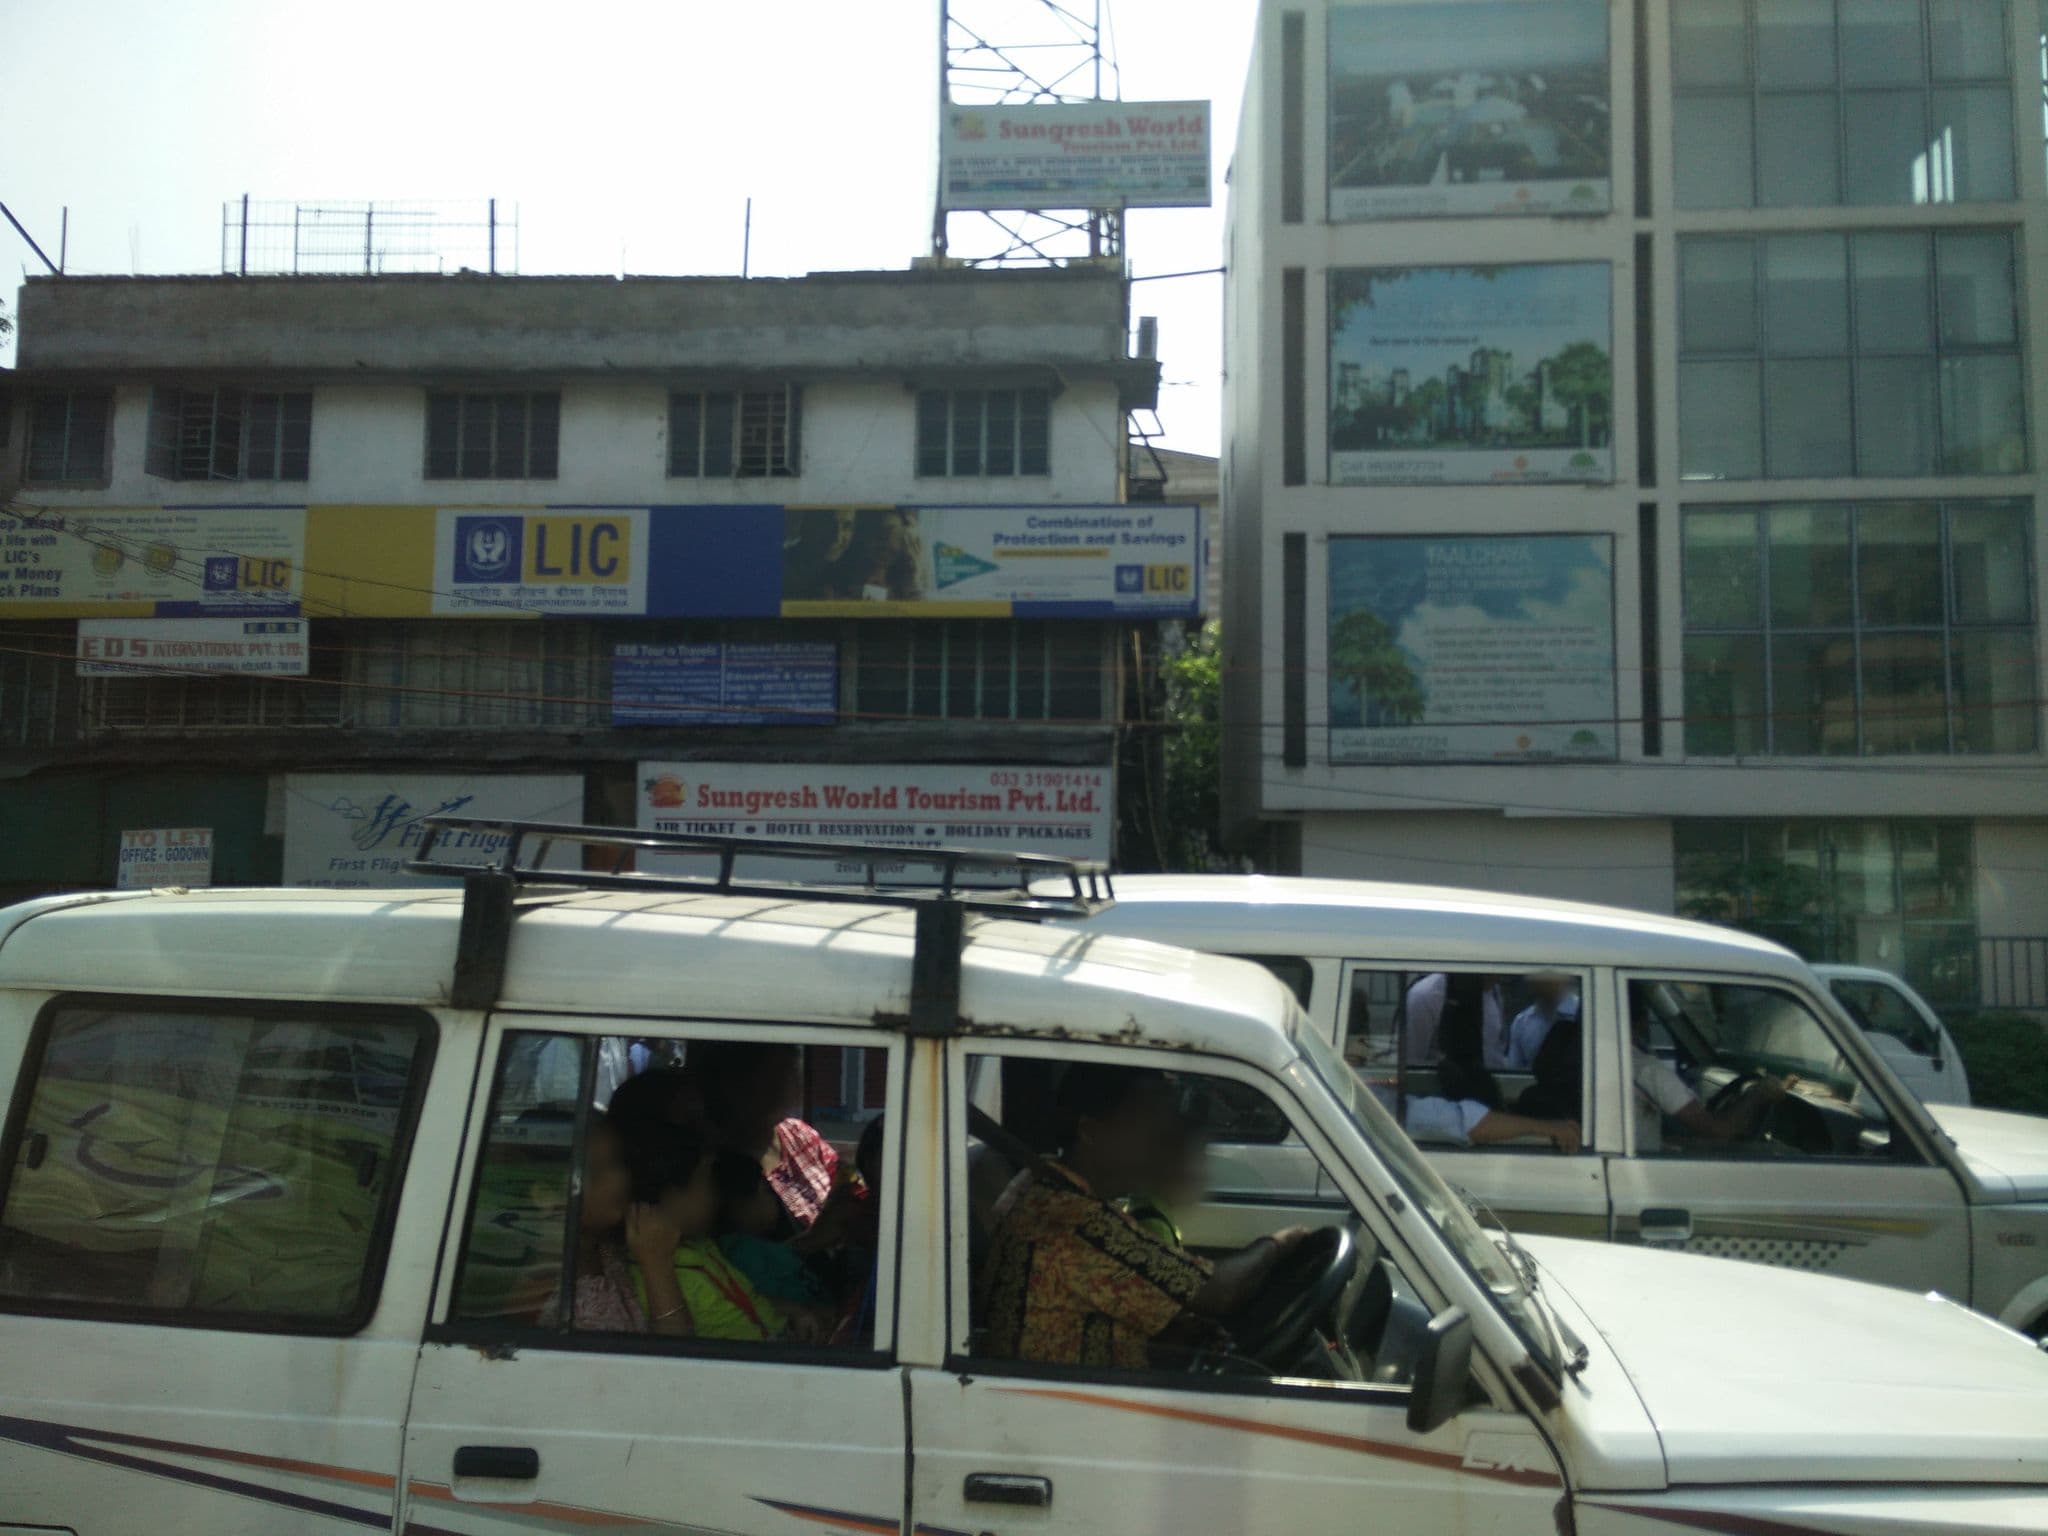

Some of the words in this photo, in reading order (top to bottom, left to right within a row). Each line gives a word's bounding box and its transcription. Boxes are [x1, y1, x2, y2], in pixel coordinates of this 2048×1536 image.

[999, 117, 1121, 145] Sungresh
[1126, 114, 1204, 137] World
[1026, 516, 1133, 529] Combination
[1137, 515, 1154, 529] of
[31, 535, 57, 545] with
[993, 532, 1083, 546] Protection
[1086, 532, 1117, 545] and
[1121, 532, 1187, 548] Savings
[5, 550, 40, 563] LIC's
[535, 523, 620, 578] LIC
[15, 568, 62, 582] Money
[245, 560, 286, 588] LIC
[1148, 567, 1186, 592] LIC
[20, 584, 60, 597] Plans
[989, 772, 1019, 787] 033
[697, 784, 818, 815] Sungresh
[822, 785, 898, 811] World
[905, 786, 1001, 811] Tourism
[1007, 788, 1052, 813] Pvt.
[1055, 789, 1101, 814] Ltd.
[124, 831, 158, 847] TO
[165, 830, 209, 847] LET
[655, 822, 680, 834] AIR
[686, 822, 736, 835] TICKET
[766, 823, 812, 836] HOTEL
[818, 823, 915, 837] RESERVATION
[945, 825, 1012, 838] HOLIDAY
[1017, 826, 1092, 840] PACKAGES
[121, 847, 157, 863] OFFICE
[165, 846, 209, 862] GODOWN
[329, 858, 366, 872] First
